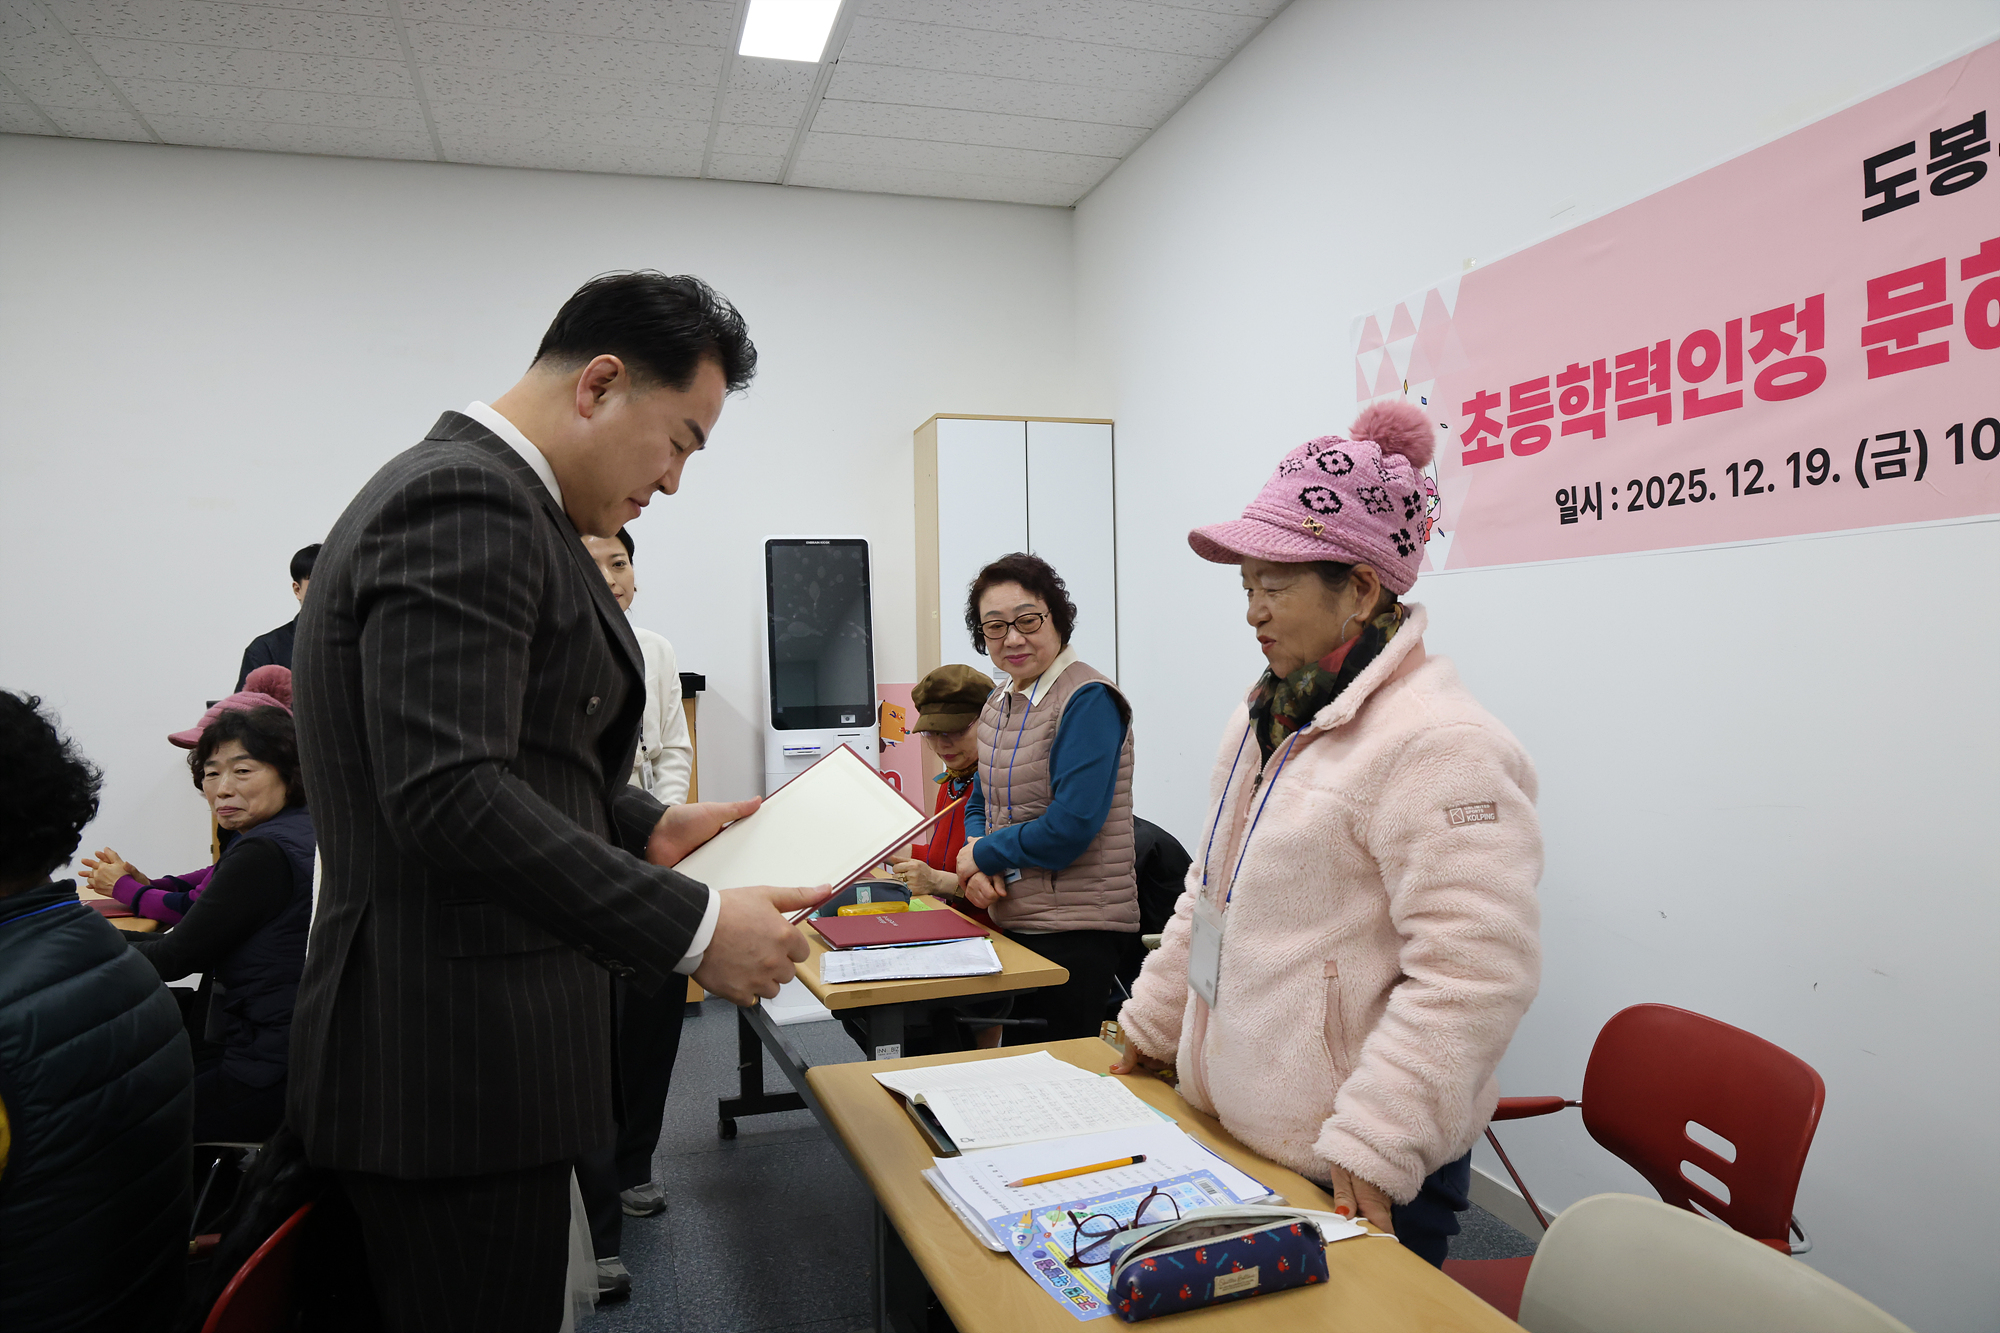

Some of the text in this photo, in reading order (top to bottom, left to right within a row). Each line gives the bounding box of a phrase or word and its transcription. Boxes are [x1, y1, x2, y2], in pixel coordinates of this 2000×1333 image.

[1862, 110, 2000, 222] 도봉
[1460, 293, 1827, 466] 초등학력인정
[1555, 481, 1602, 525] 일시
[1627, 468, 1716, 512] 2025.
[1726, 458, 1775, 497] 12.
[1786, 447, 1840, 488] 19.
[1855, 428, 1928, 489] (금)
[1466, 813, 1495, 822] KOLPING
[1061, 1286, 1099, 1311] 구구단
